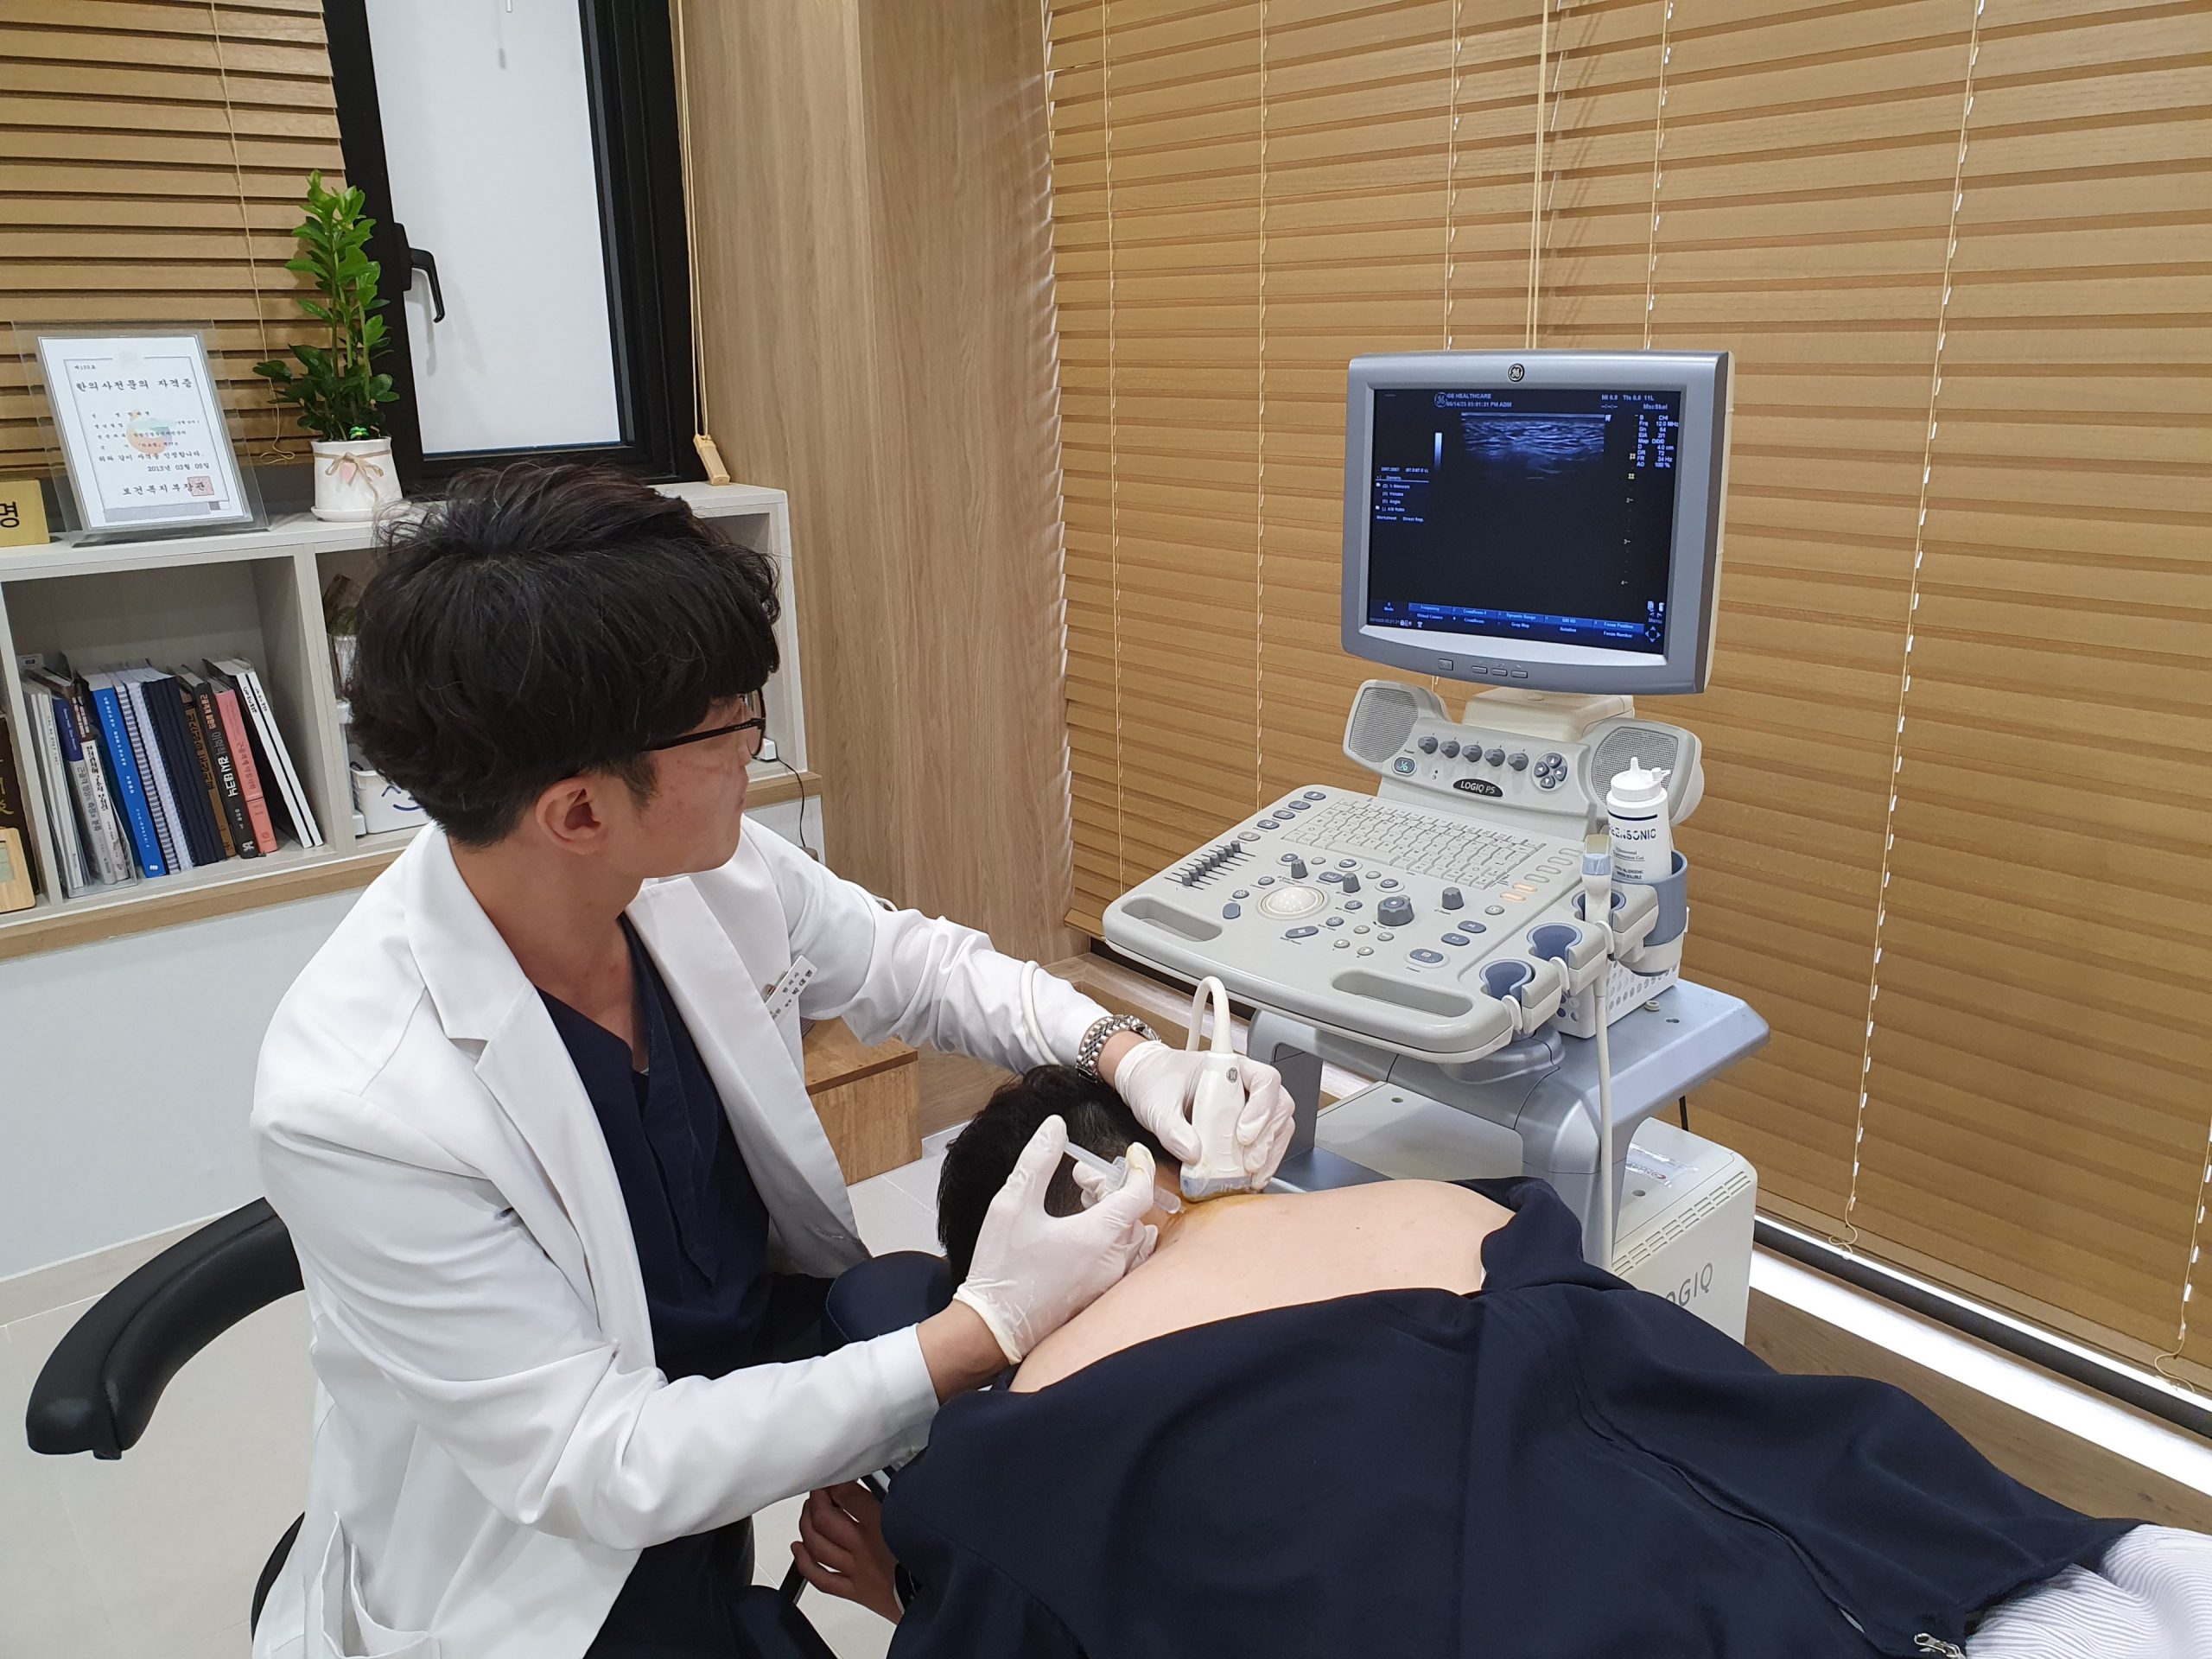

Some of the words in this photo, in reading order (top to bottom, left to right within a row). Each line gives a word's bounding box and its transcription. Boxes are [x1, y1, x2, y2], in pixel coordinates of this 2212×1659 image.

[76, 379, 149, 391] 한의사전문의
[158, 378, 192, 389] 자격증
[123, 481, 205, 495] 보건복지부장관
[217, 754, 231, 772] 검사
[222, 772, 238, 797] 테크닉
[1460, 780, 1484, 793] LOGIQ
[1485, 786, 1496, 795] P5
